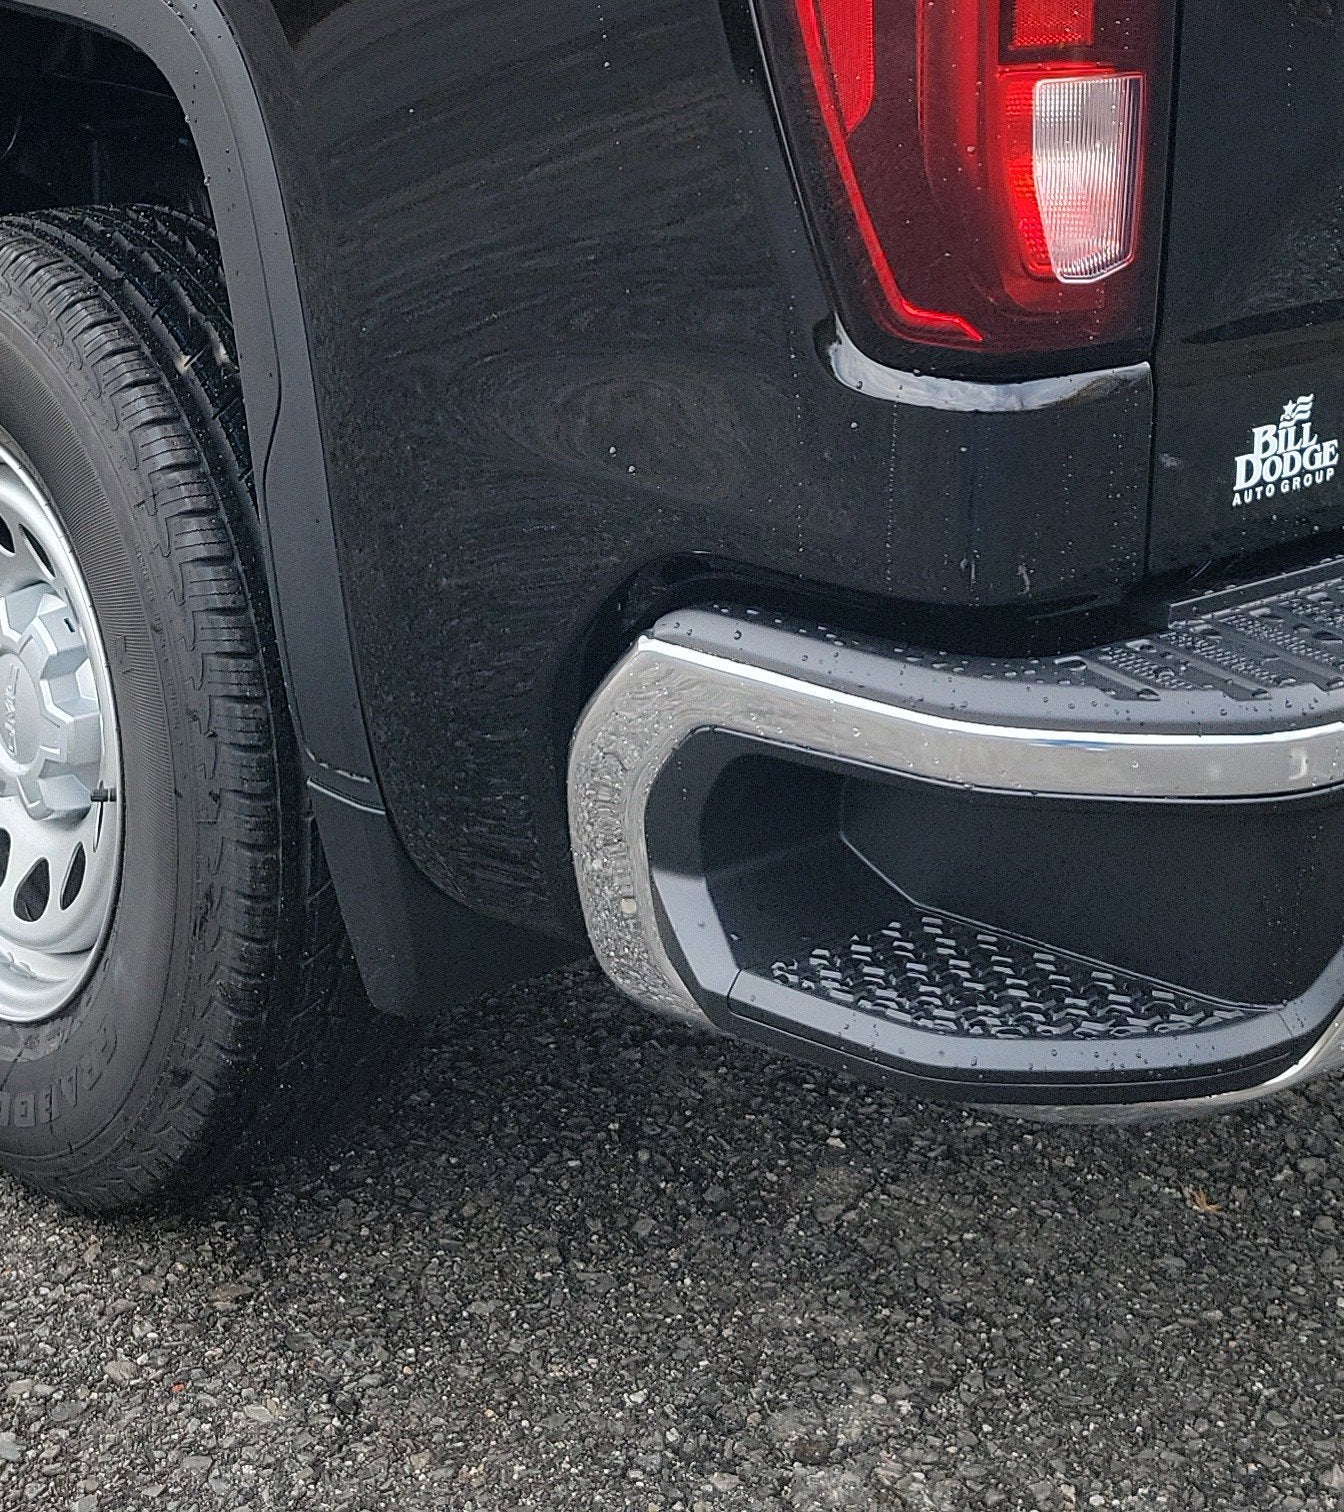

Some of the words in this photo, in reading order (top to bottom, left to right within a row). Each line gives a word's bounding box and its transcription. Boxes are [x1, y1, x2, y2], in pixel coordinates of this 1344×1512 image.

[1252, 421, 1318, 459] BILL
[1233, 439, 1339, 491] DODGE
[1232, 483, 1275, 506] AUTO
[1280, 467, 1335, 494] GROUP
